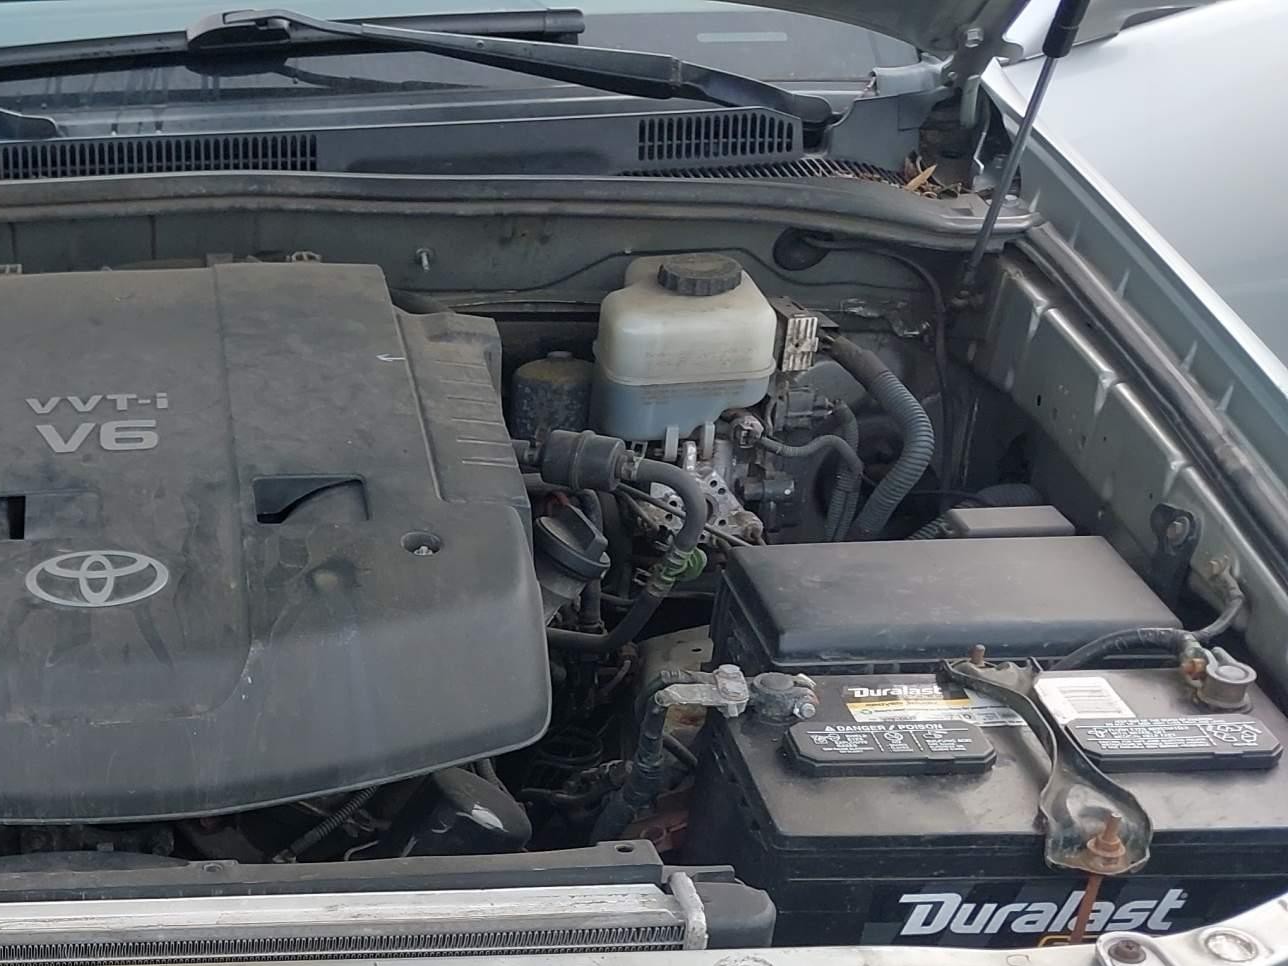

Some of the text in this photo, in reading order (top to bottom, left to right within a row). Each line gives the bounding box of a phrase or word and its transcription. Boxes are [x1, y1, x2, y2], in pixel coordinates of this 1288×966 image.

[25, 392, 169, 414] VVT-i
[35, 419, 160, 453] V6
[847, 684, 942, 698] Duralast
[836, 723, 886, 731] DANGER
[897, 723, 944, 731] POISON
[898, 888, 1186, 936] Duralast
